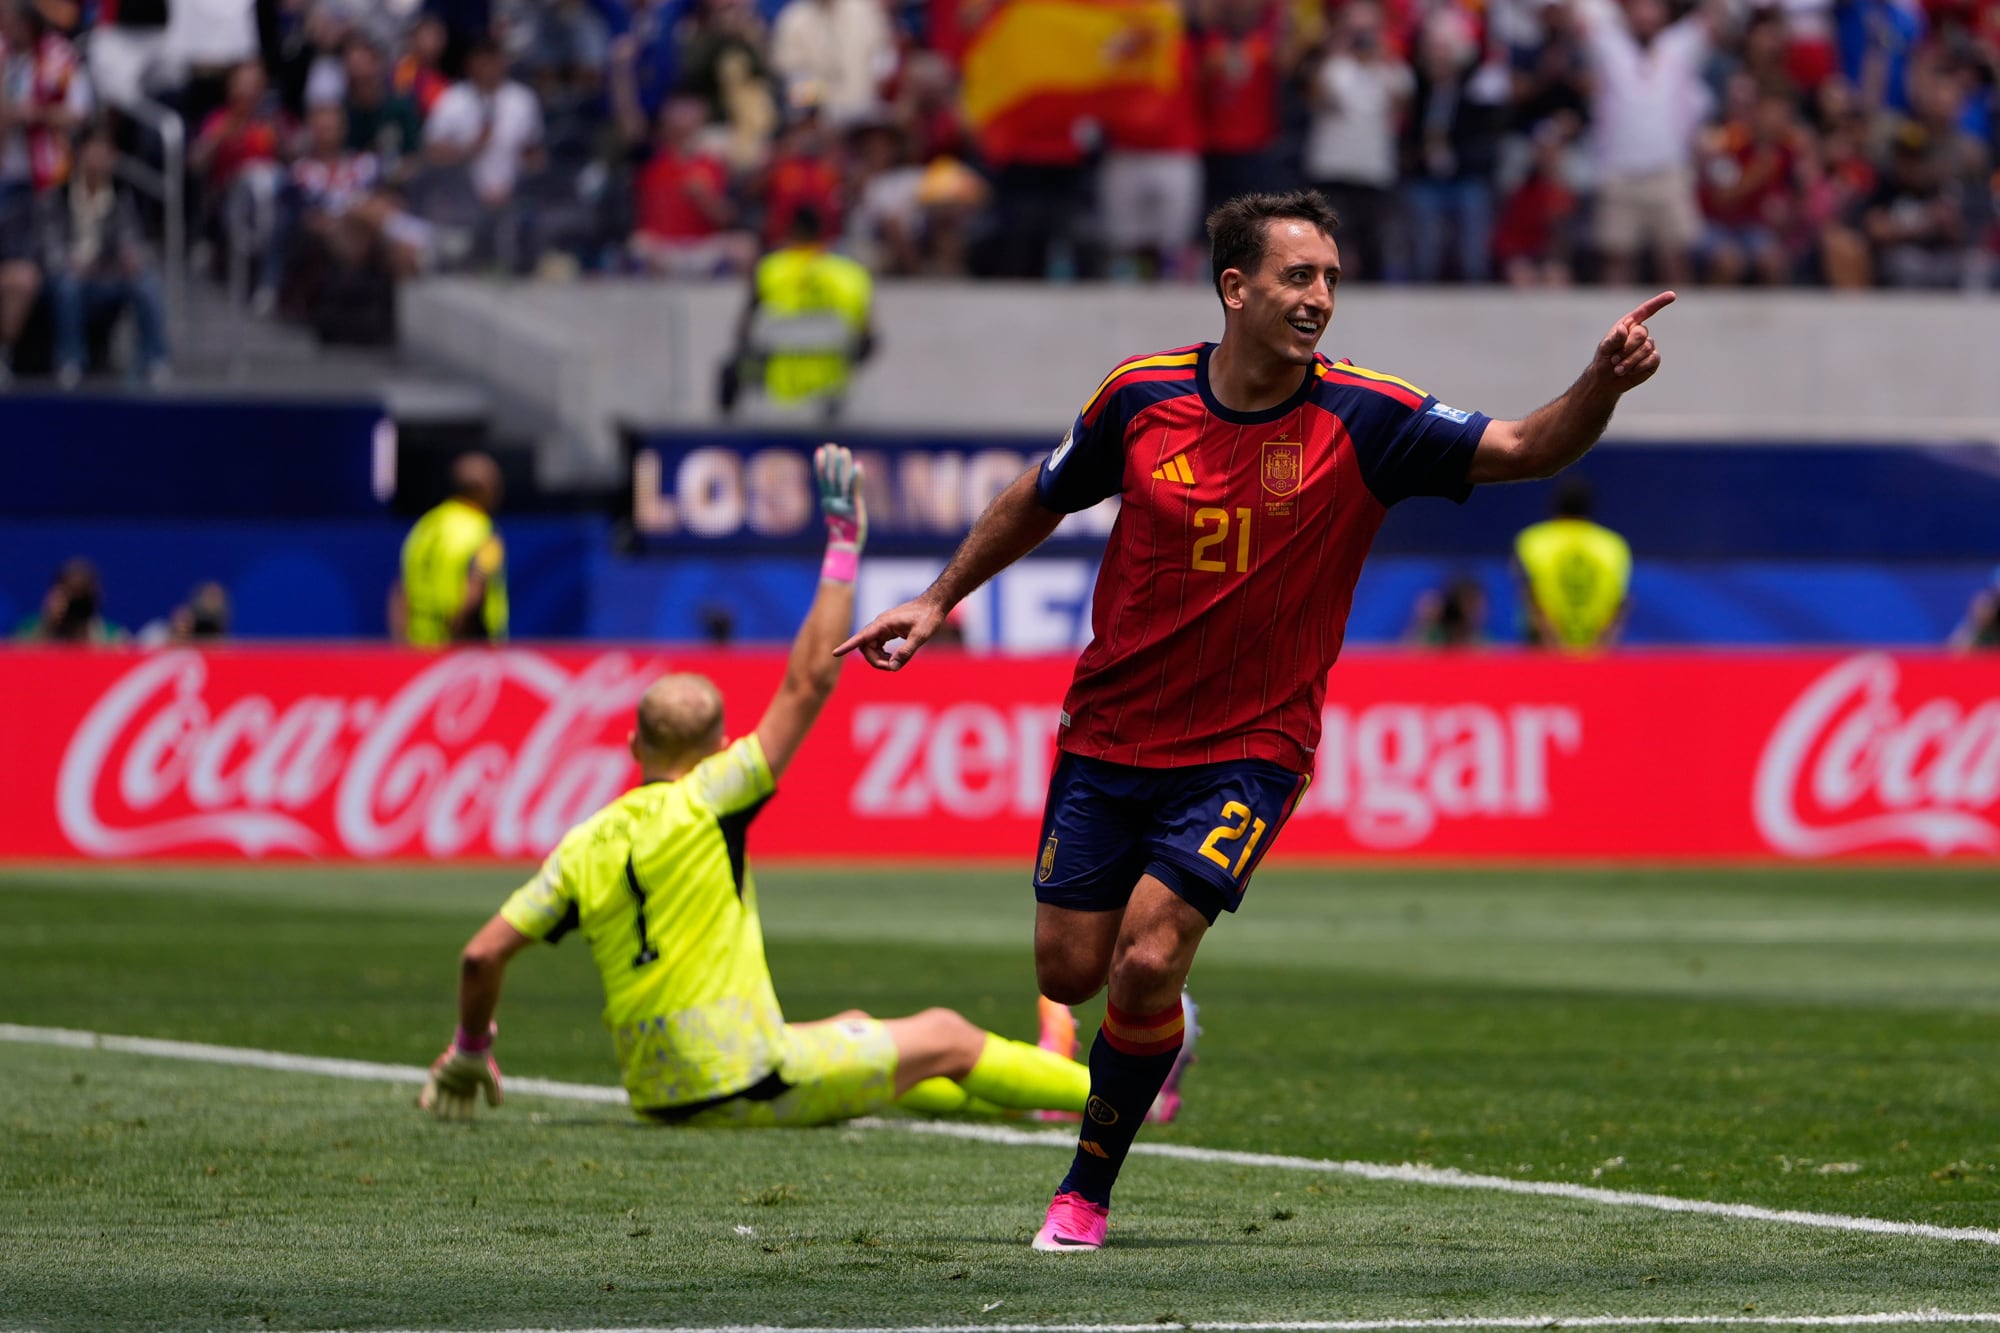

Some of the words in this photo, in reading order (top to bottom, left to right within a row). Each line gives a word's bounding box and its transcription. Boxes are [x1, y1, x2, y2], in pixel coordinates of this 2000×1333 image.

[634, 447, 812, 538] LOS
[1192, 507, 1251, 573] 21
[853, 557, 1095, 652] FIF
[852, 702, 1058, 816] zer
[1297, 704, 1583, 848] ugar
[1198, 800, 1267, 879] 21
